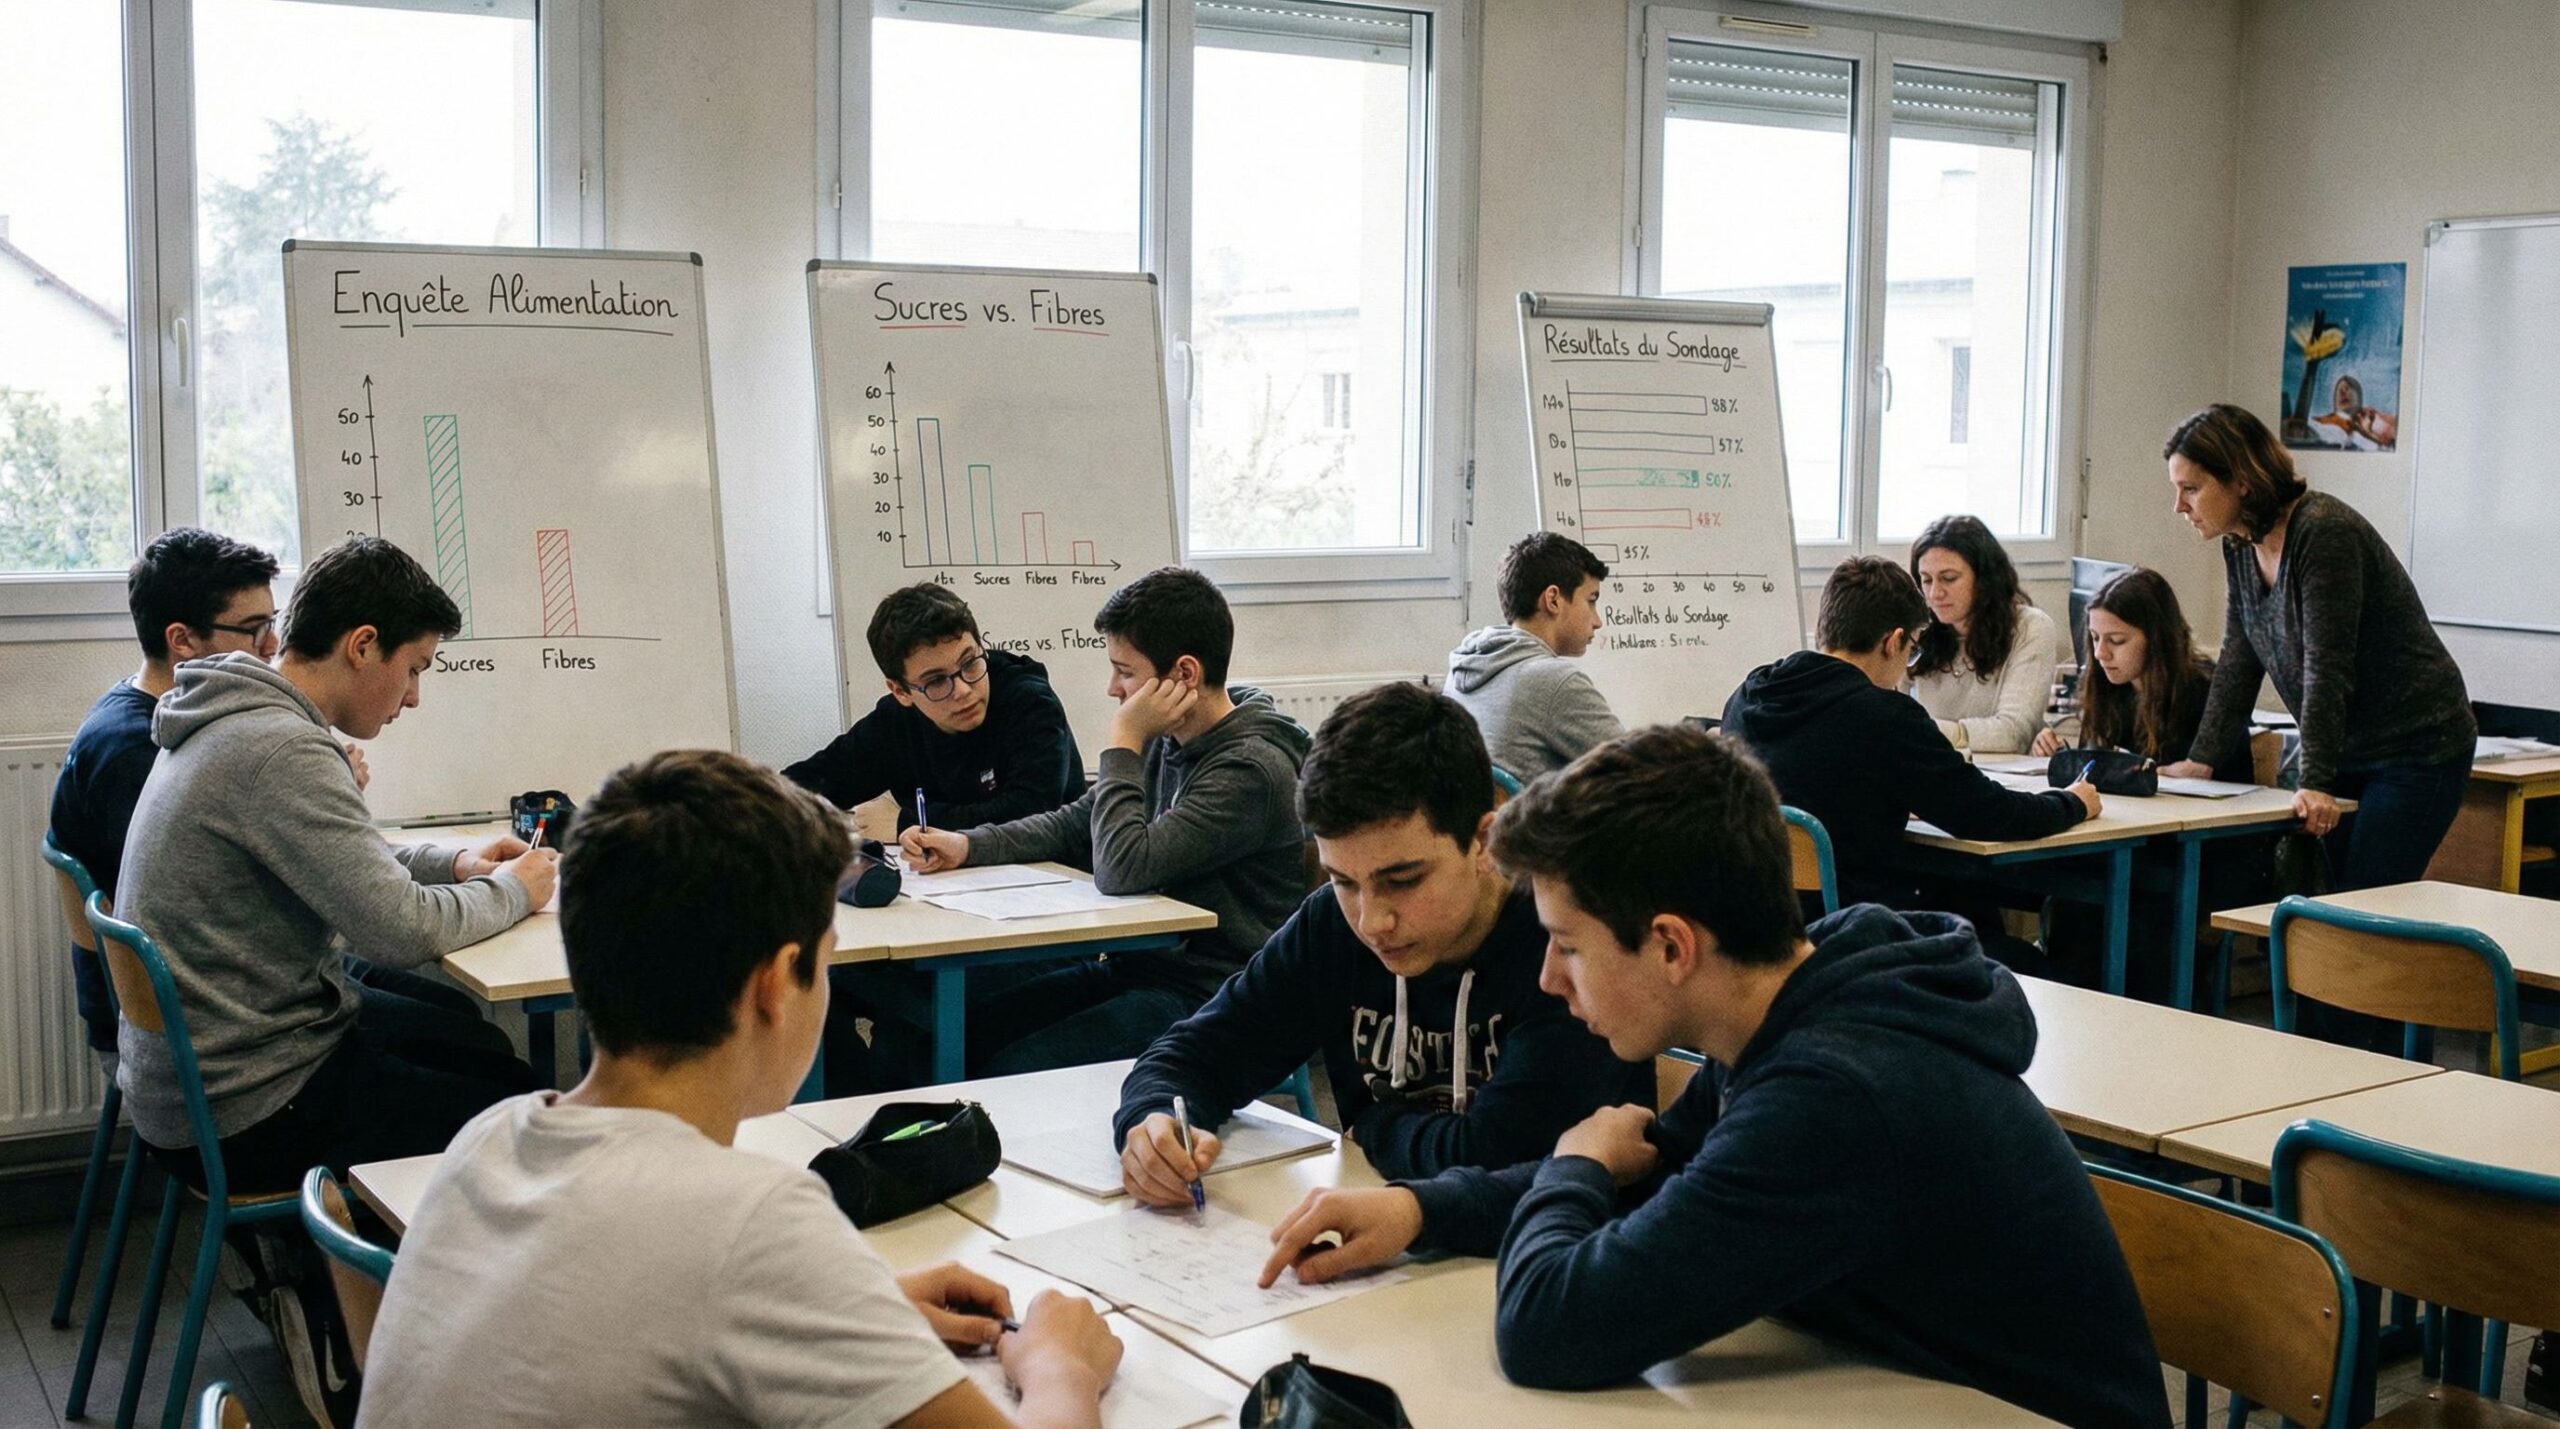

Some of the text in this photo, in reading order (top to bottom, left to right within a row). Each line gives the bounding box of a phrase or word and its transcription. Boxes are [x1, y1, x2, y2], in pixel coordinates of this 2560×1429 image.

[333, 270, 679, 338] Enquête Alimentation
[873, 282, 1105, 326] Sucres vs. Fibres
[1544, 323, 1741, 373] Résultats du Sondage
[865, 385, 882, 400] 60
[337, 408, 360, 425] 50
[867, 414, 885, 428] 50
[869, 443, 887, 456] 40
[1718, 437, 1744, 455] 57%
[340, 450, 362, 466] 40
[872, 471, 890, 485] 30
[343, 490, 365, 507] 30
[874, 501, 891, 514] 20
[876, 531, 892, 543] 10
[973, 571, 1010, 585] Sucres
[1025, 571, 1058, 585] Fibres
[1072, 571, 1106, 585] Fibres
[1642, 581, 1656, 593] 20
[1672, 581, 1686, 593] 30
[1702, 581, 1717, 593] 40
[1732, 581, 1747, 593] 50
[1761, 581, 1776, 593] 60
[1605, 605, 1730, 630] Résultats du Sondage
[981, 628, 1107, 651] Sucres vs. Fibres
[434, 648, 596, 673] Sucres Fibres
